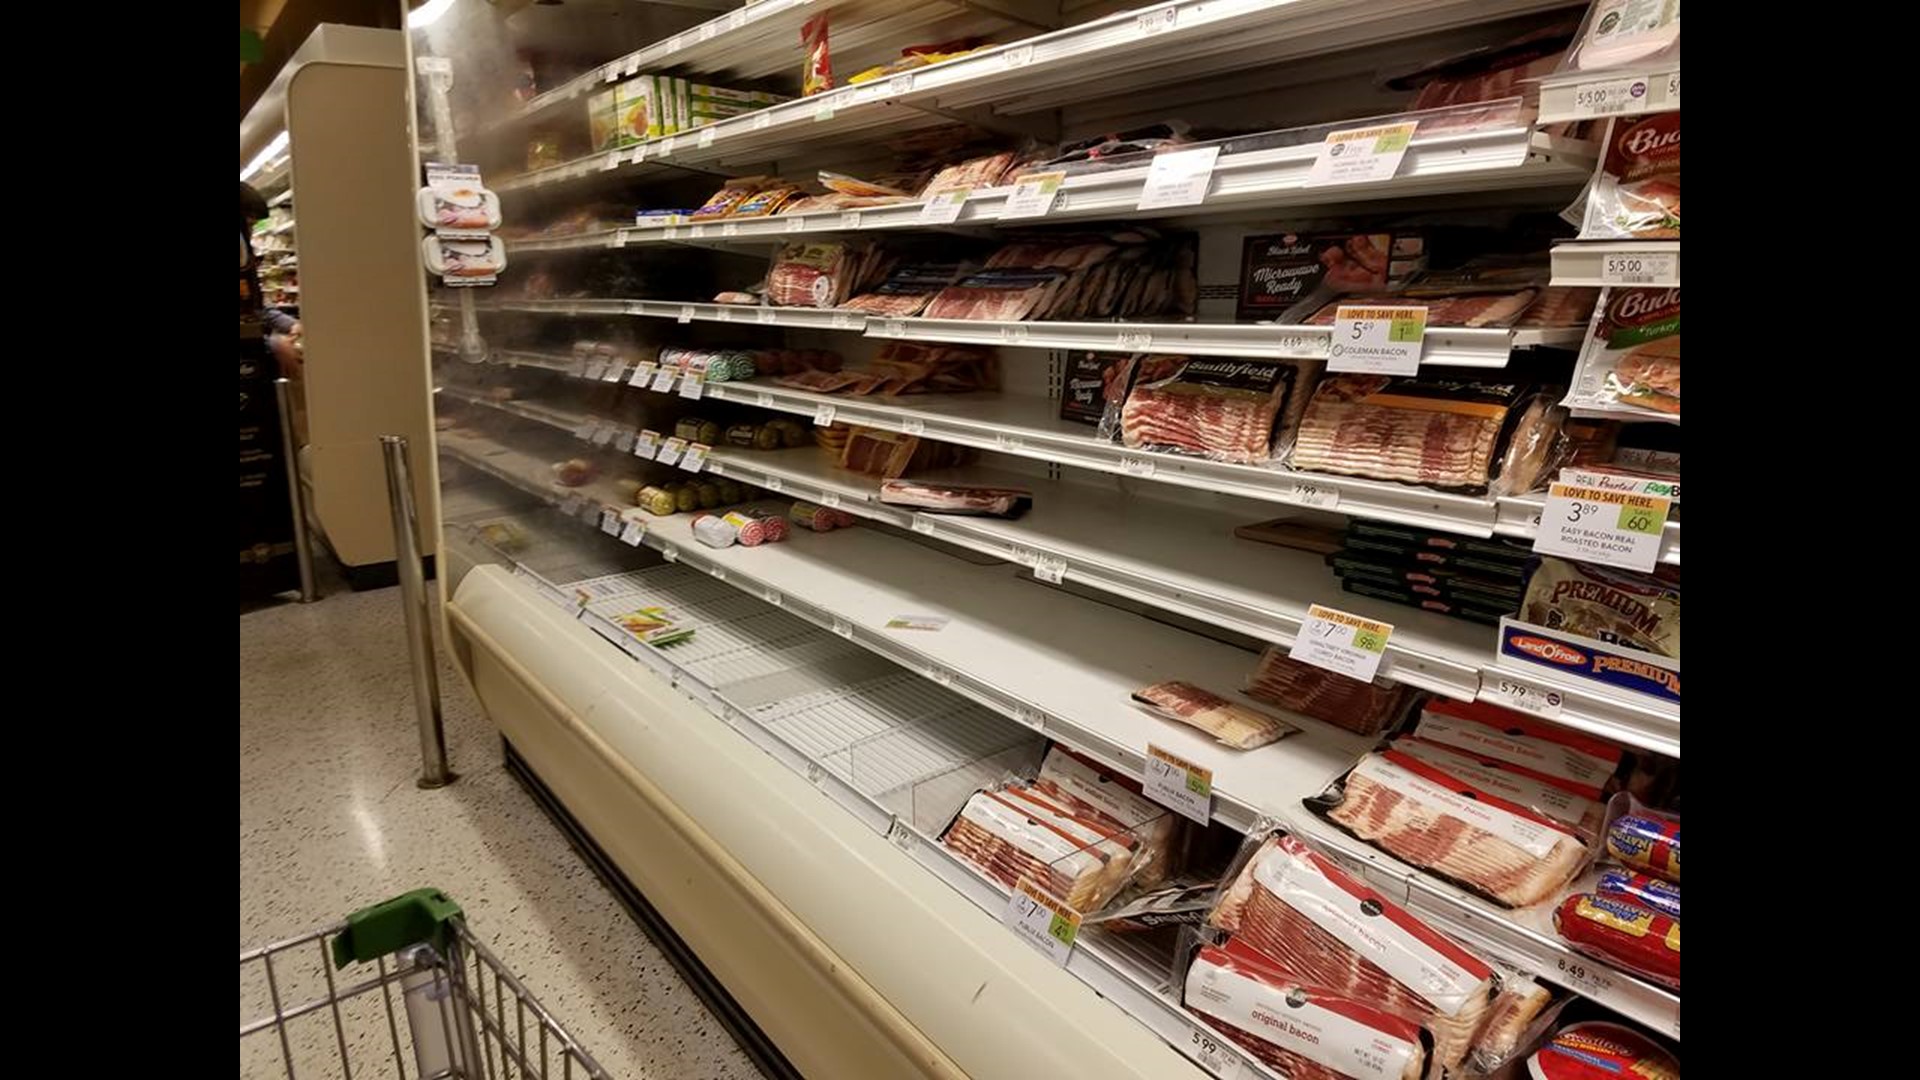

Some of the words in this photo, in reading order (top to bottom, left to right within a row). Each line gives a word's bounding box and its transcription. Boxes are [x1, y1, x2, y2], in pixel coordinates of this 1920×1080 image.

[1253, 264, 1320, 282] Microwave
[1266, 277, 1302, 295] Ready
[1347, 310, 1365, 319] LOVE
[1366, 310, 1376, 319] TO
[1377, 310, 1395, 319] SAVE
[1343, 347, 1379, 355] COLEMAN
[1380, 347, 1408, 356] BACON
[1189, 361, 1278, 378] Smithfield
[1563, 486, 1587, 499] LOVE
[1588, 489, 1601, 500] TO
[1602, 492, 1626, 505] SAVE
[1561, 526, 1582, 537] EASY
[1583, 529, 1614, 541] BACON
[1615, 535, 1636, 545] REAL
[1561, 536, 1599, 548] ROASTED
[1601, 542, 1633, 553] BACON
[1551, 580, 1661, 635] PREMIUM
[1593, 656, 1680, 694] PREMIUM
[1558, 959, 1585, 979] 8.49
[1251, 1008, 1288, 1032] original
[1289, 1025, 1320, 1046] bacon
